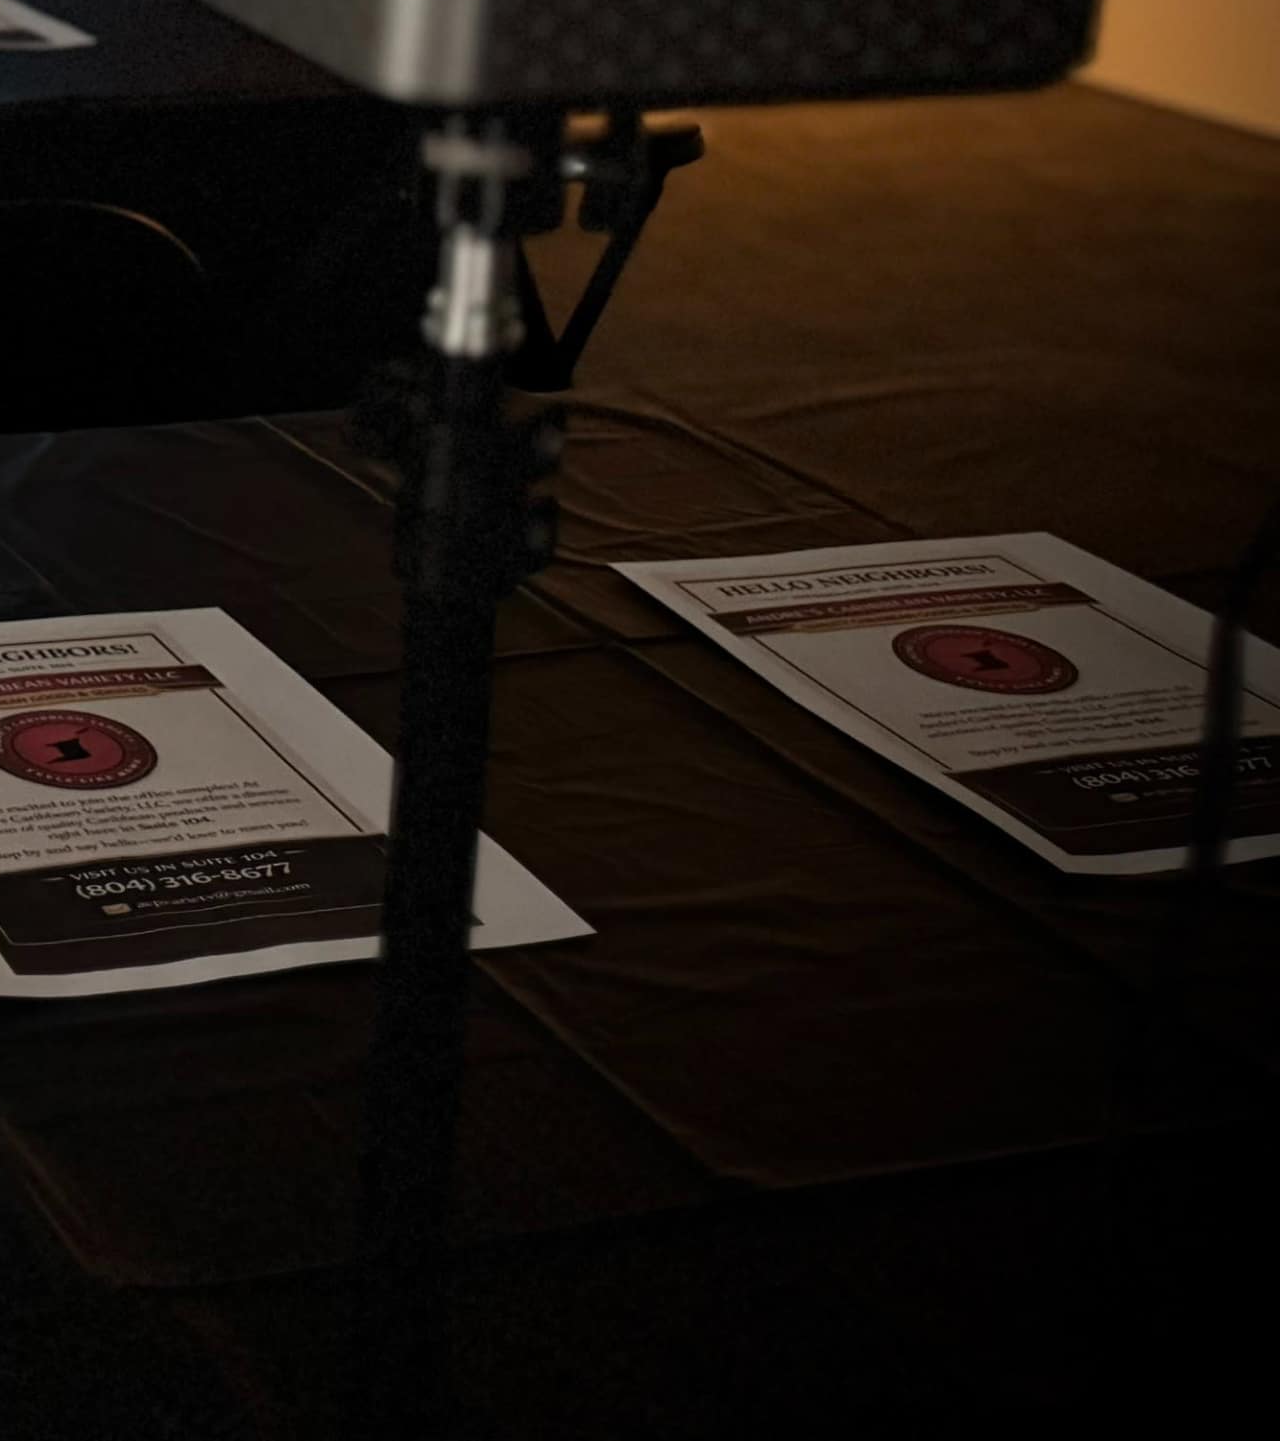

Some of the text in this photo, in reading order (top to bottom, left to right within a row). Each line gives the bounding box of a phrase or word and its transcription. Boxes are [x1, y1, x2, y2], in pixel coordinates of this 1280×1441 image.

[716, 580, 814, 597] HELLO
[816, 564, 996, 587] NEIGHBORS!
[55, 673, 143, 686] VARIETY,
[144, 671, 180, 680] LLC
[1143, 754, 1274, 780] 31677
[69, 850, 278, 880] VISIT US IN SUITE 104
[76, 877, 156, 900] (804)
[159, 862, 290, 888] 316-8677
